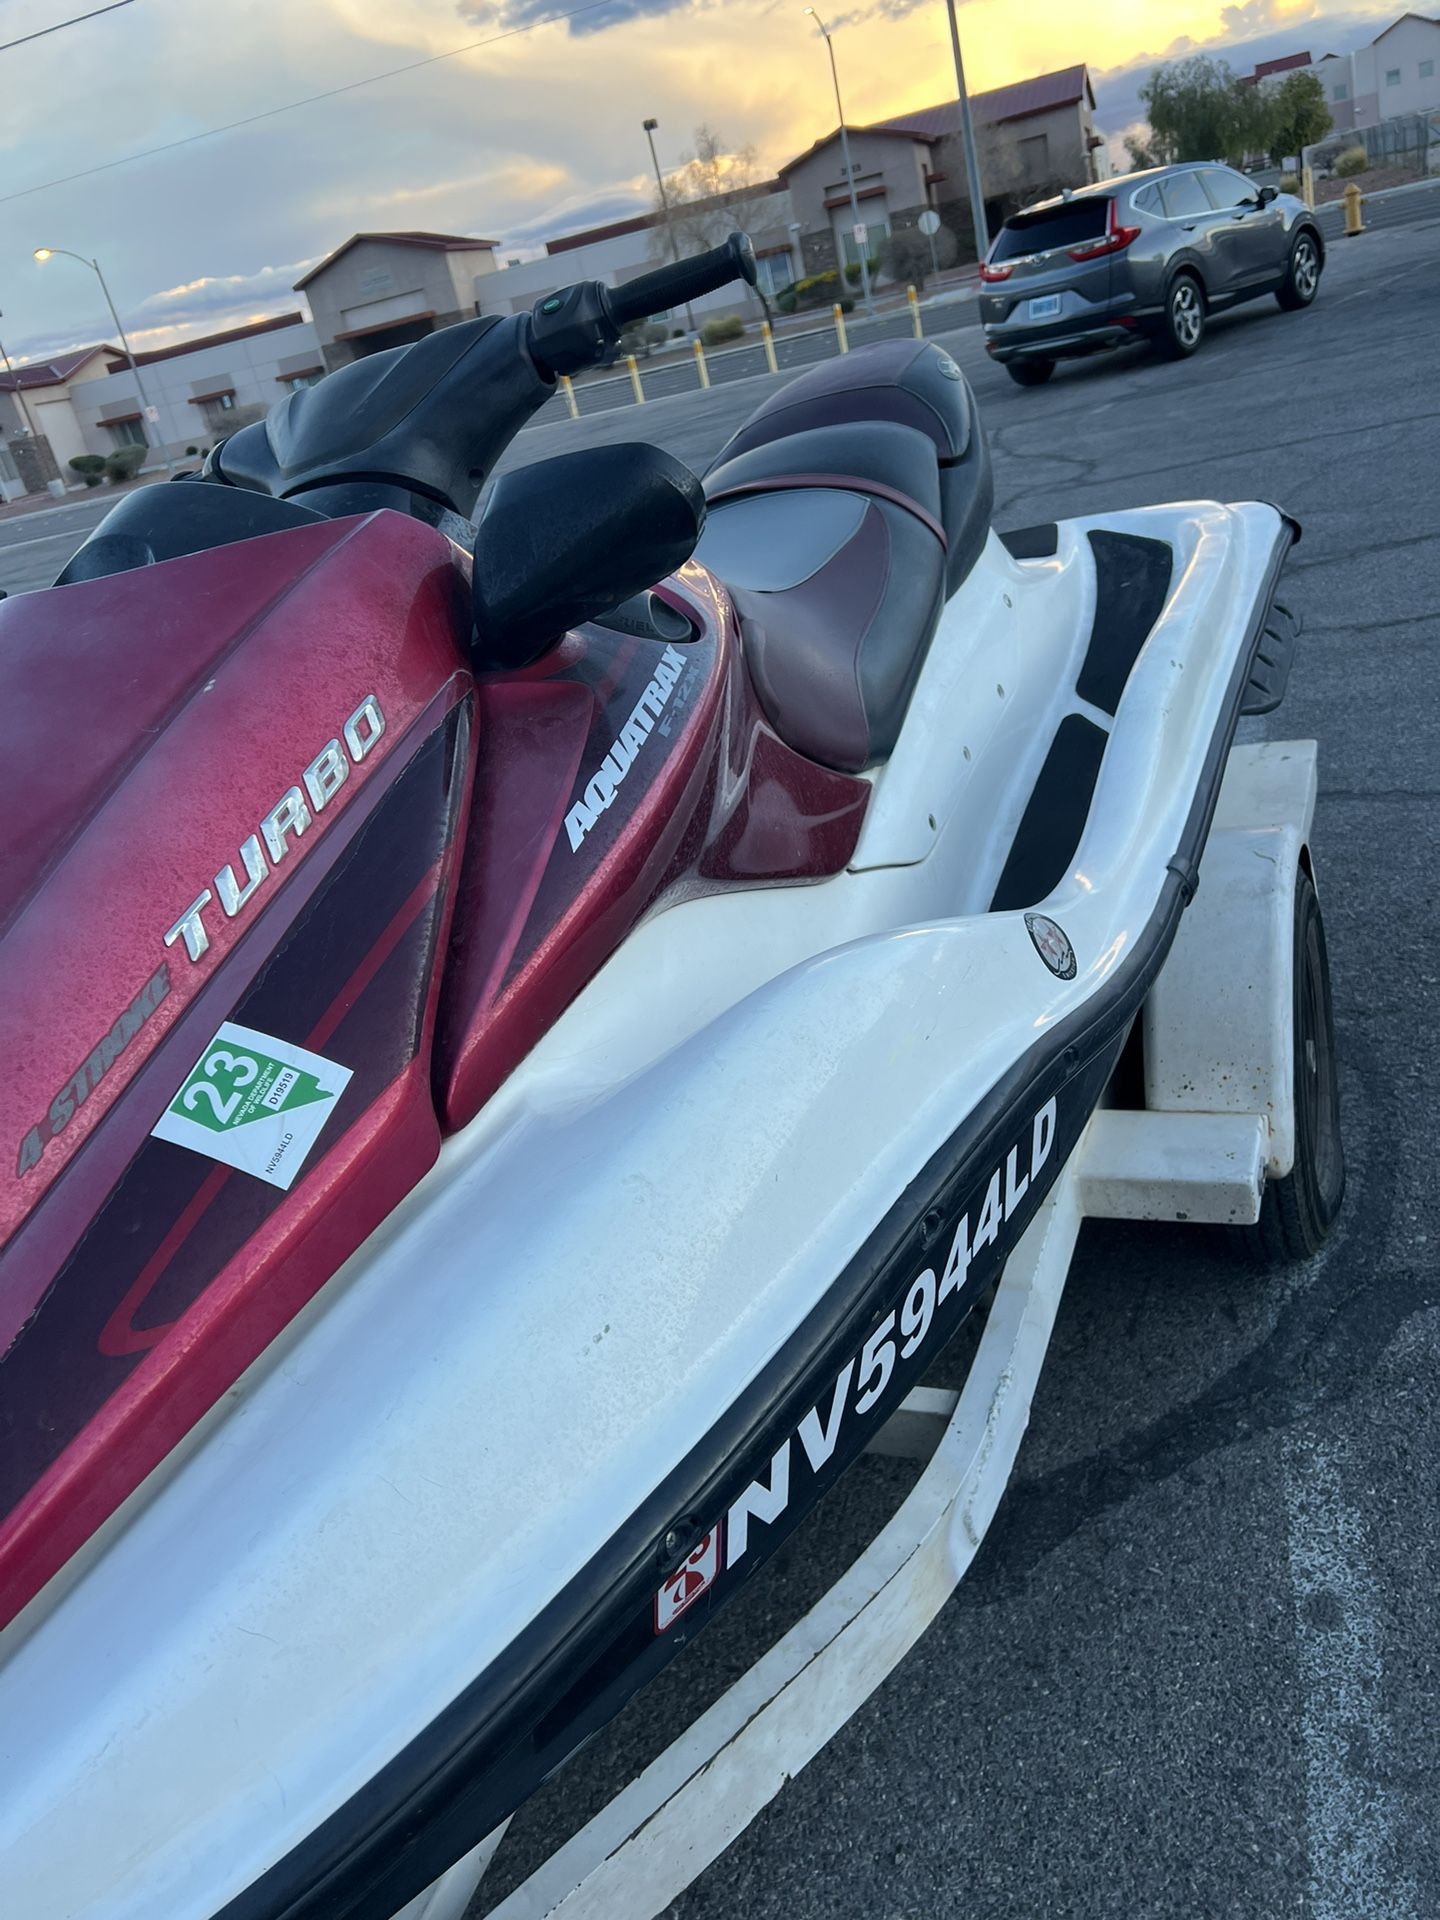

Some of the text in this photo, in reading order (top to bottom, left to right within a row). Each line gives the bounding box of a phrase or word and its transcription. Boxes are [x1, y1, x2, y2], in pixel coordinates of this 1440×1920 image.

[564, 643, 688, 854] AQUATRAX
[163, 694, 387, 962] TURBO
[17, 961, 171, 1179] 4 STROKE
[183, 1050, 259, 1125] 23
[232, 1062, 275, 1125] NEVADA DEPARTMENT
[247, 1077, 274, 1114] OF WILDLIFE
[268, 1072, 294, 1105] D19519
[264, 1132, 294, 1175] NV5944LD
[727, 1096, 1057, 1570] NV5944LD
